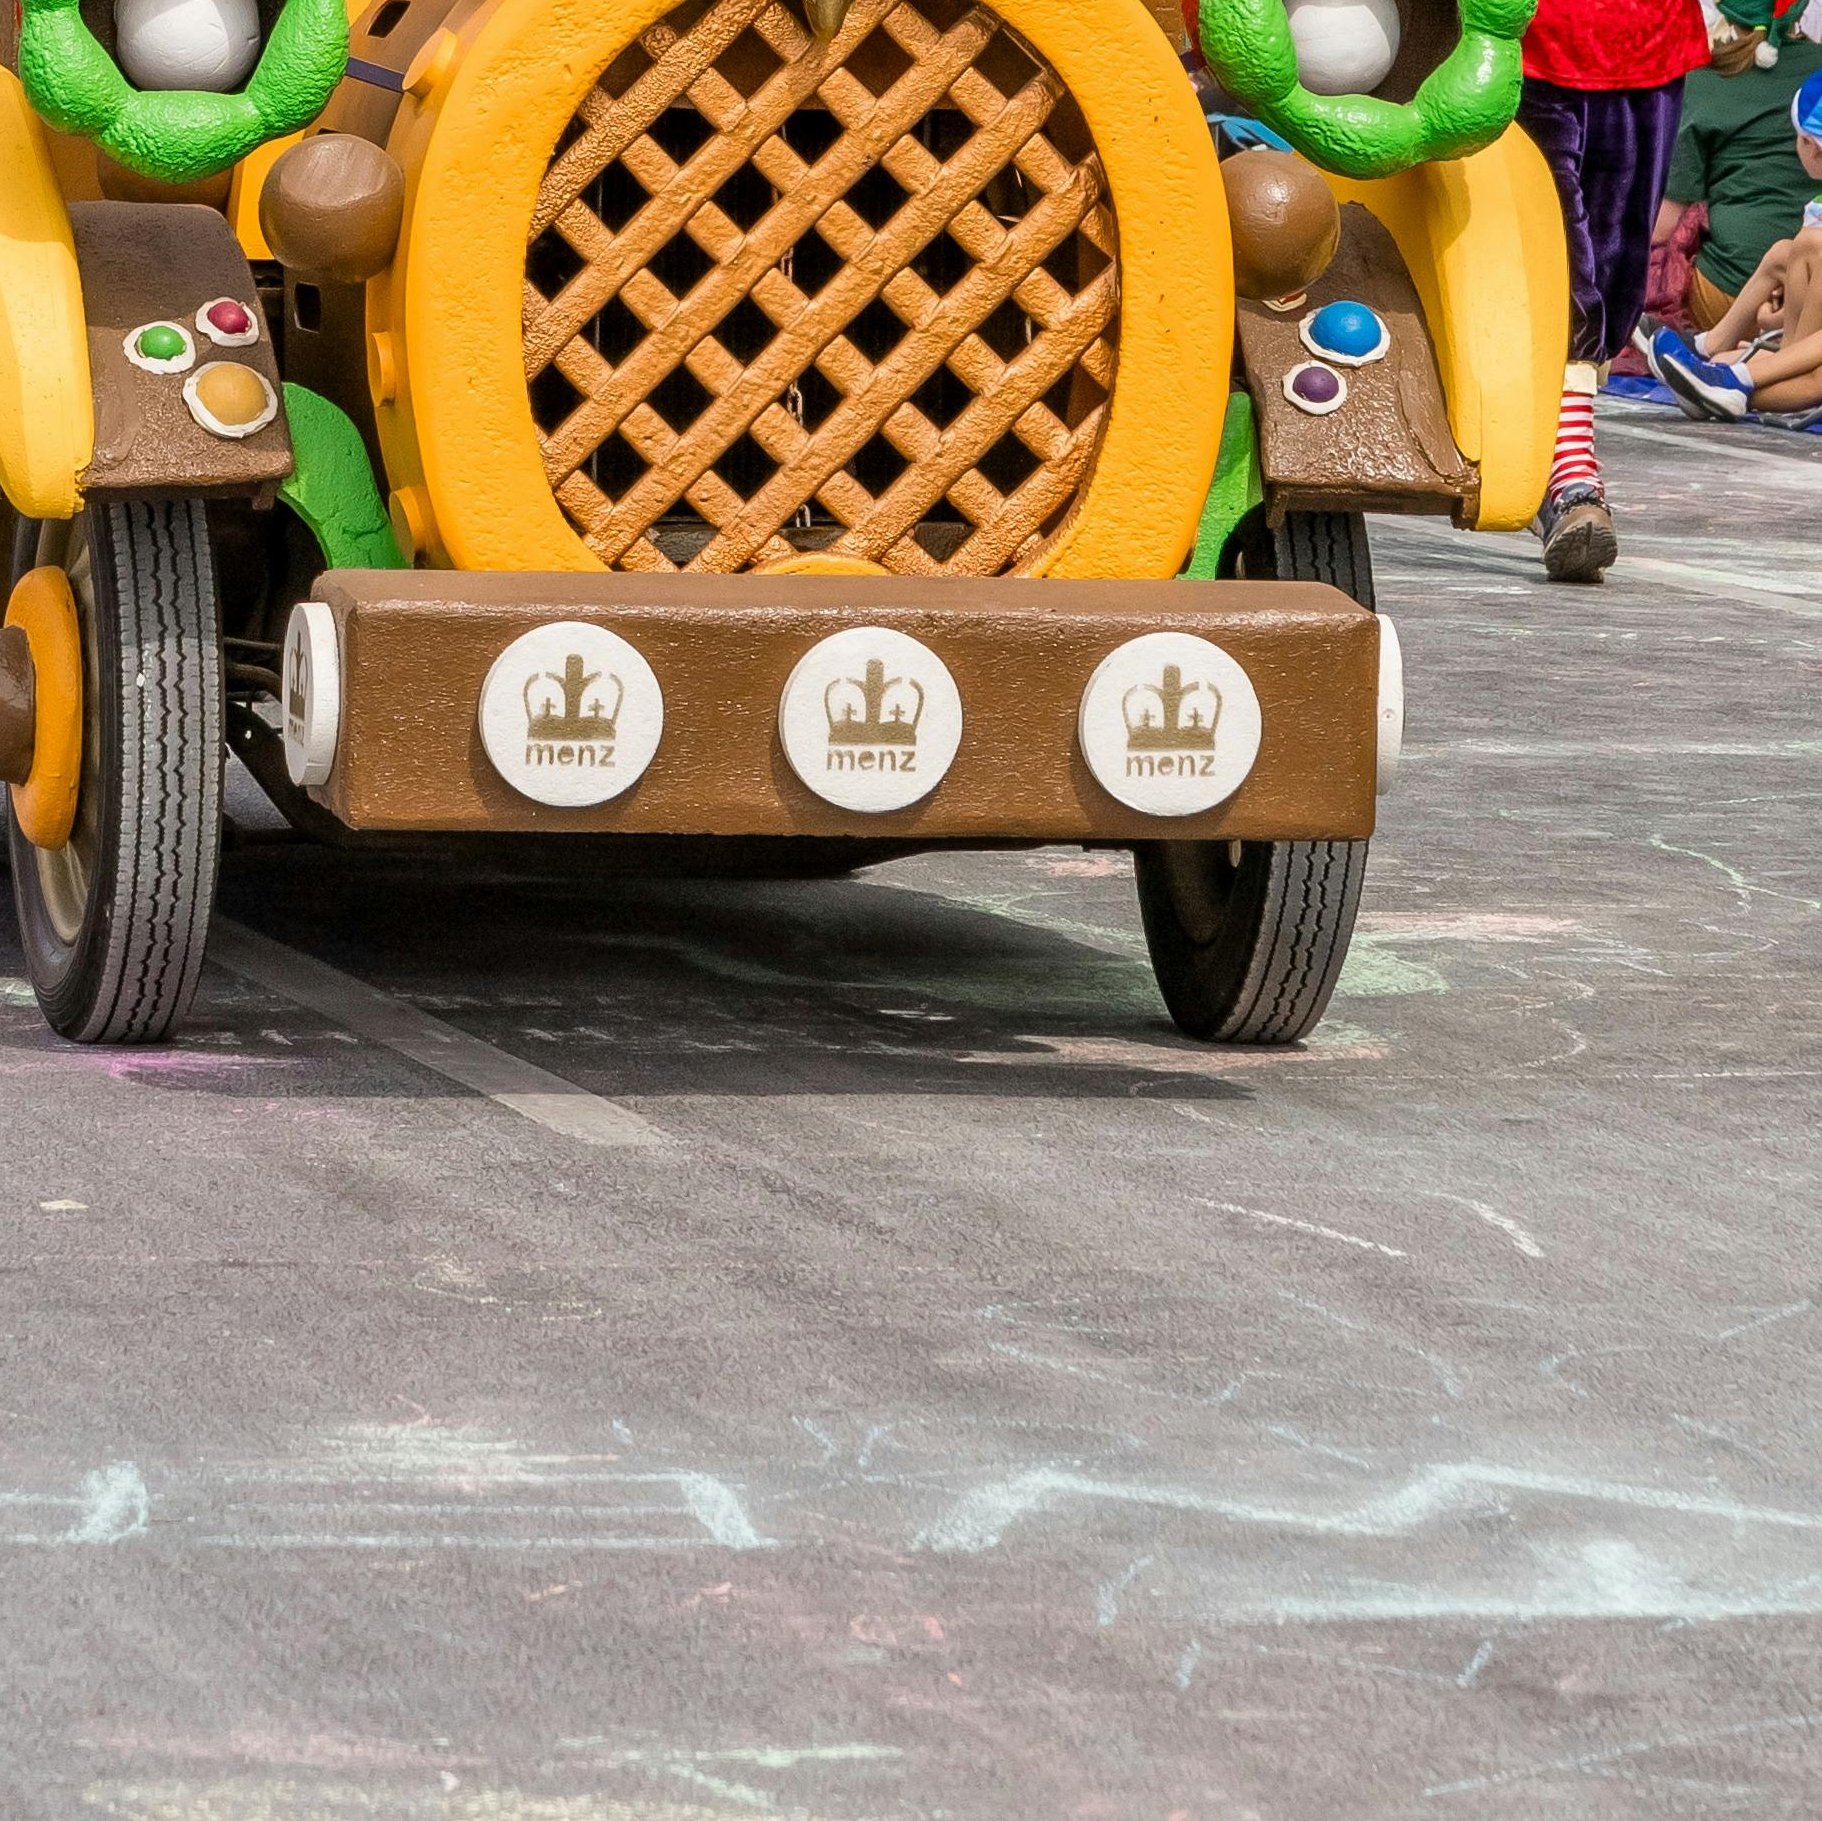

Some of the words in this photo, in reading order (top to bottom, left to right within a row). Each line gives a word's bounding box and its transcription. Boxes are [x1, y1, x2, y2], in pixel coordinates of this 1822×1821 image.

[525, 743, 616, 768] menz
[826, 749, 916, 772] menz
[1126, 754, 1216, 778] menz
